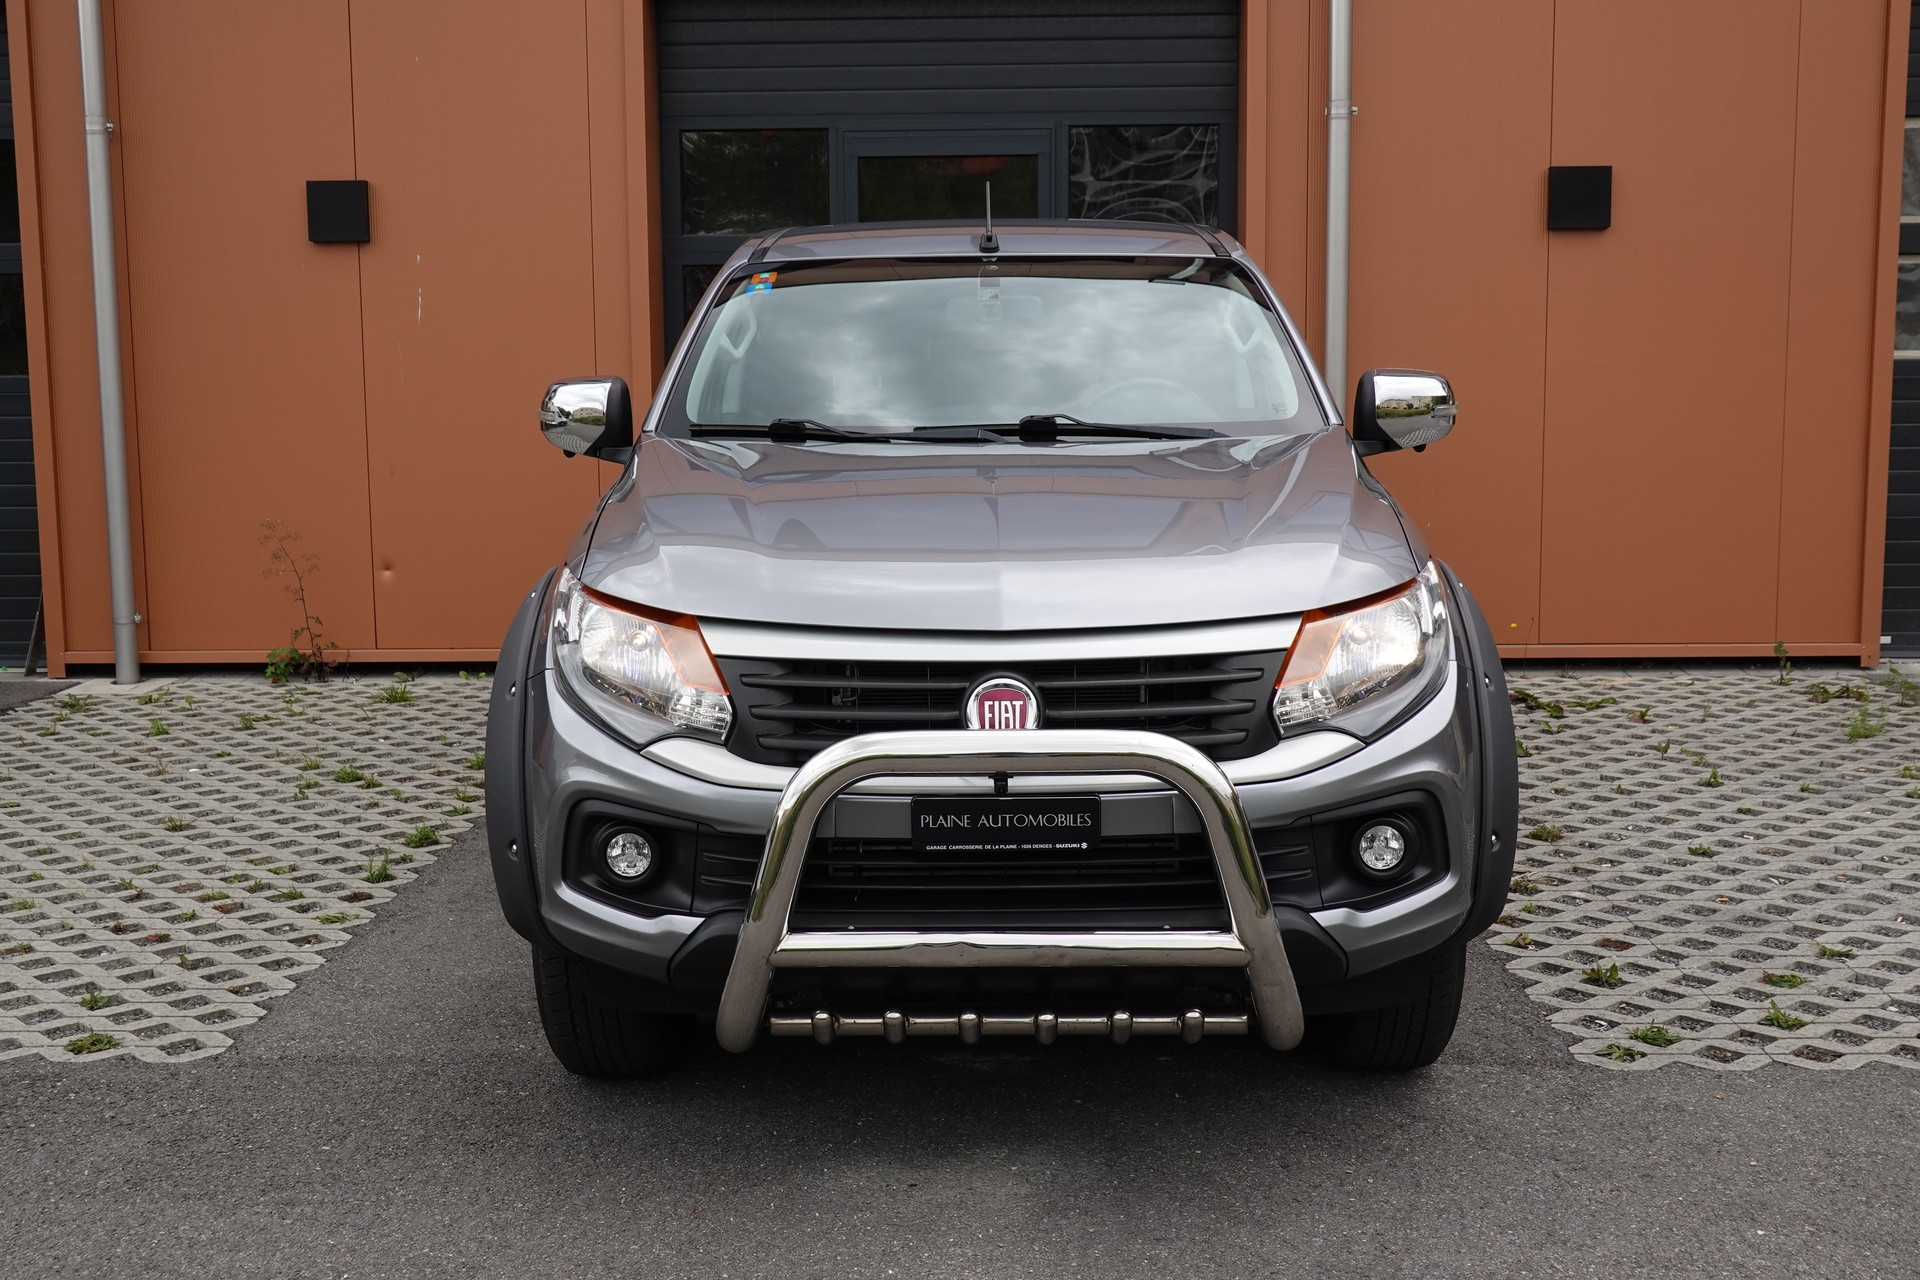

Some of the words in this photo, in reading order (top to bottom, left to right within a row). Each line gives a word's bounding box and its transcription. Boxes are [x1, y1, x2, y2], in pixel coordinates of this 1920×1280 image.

[984, 700, 1023, 729] FIAT
[920, 814, 971, 828] PLAINE
[978, 813, 1092, 827] AUTOMOBILES
